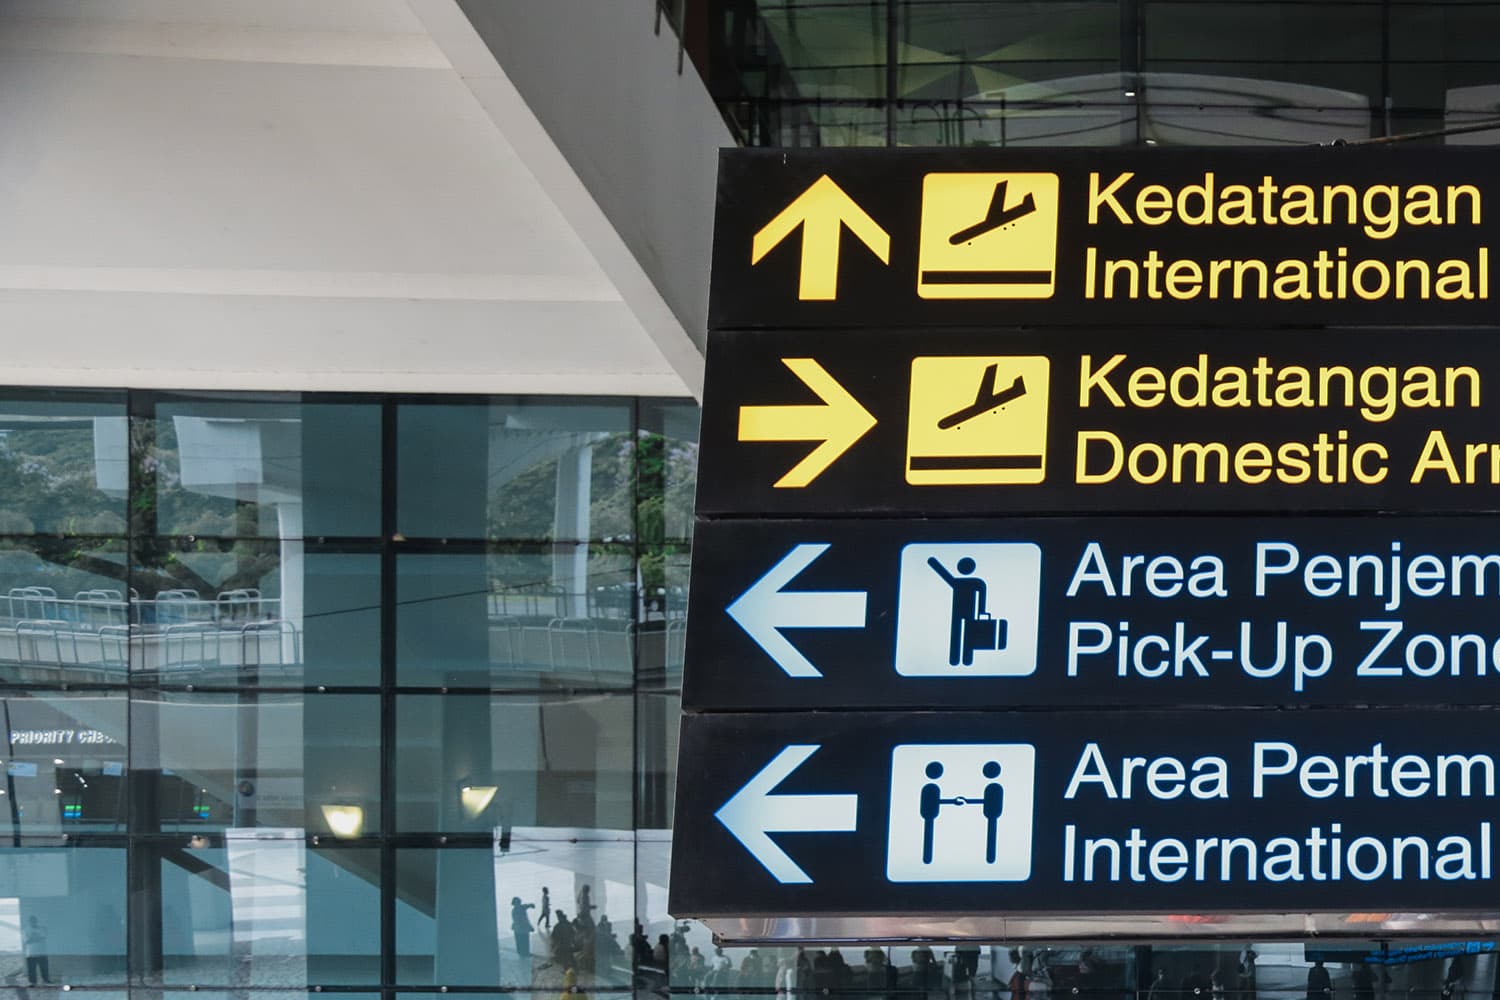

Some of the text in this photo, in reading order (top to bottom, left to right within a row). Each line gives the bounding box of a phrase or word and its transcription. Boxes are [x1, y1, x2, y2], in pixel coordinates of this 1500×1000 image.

[1088, 173, 1480, 239] Kedatangan
[1085, 247, 1488, 300] International
[1080, 354, 1479, 422] Kedatangan
[1076, 430, 1388, 484] Domestic
[1066, 542, 1228, 597] Area
[1067, 621, 1332, 692] Pick-Up
[10, 729, 74, 744] PRIORITY
[1064, 743, 1229, 799] Area
[1064, 822, 1491, 882] International
